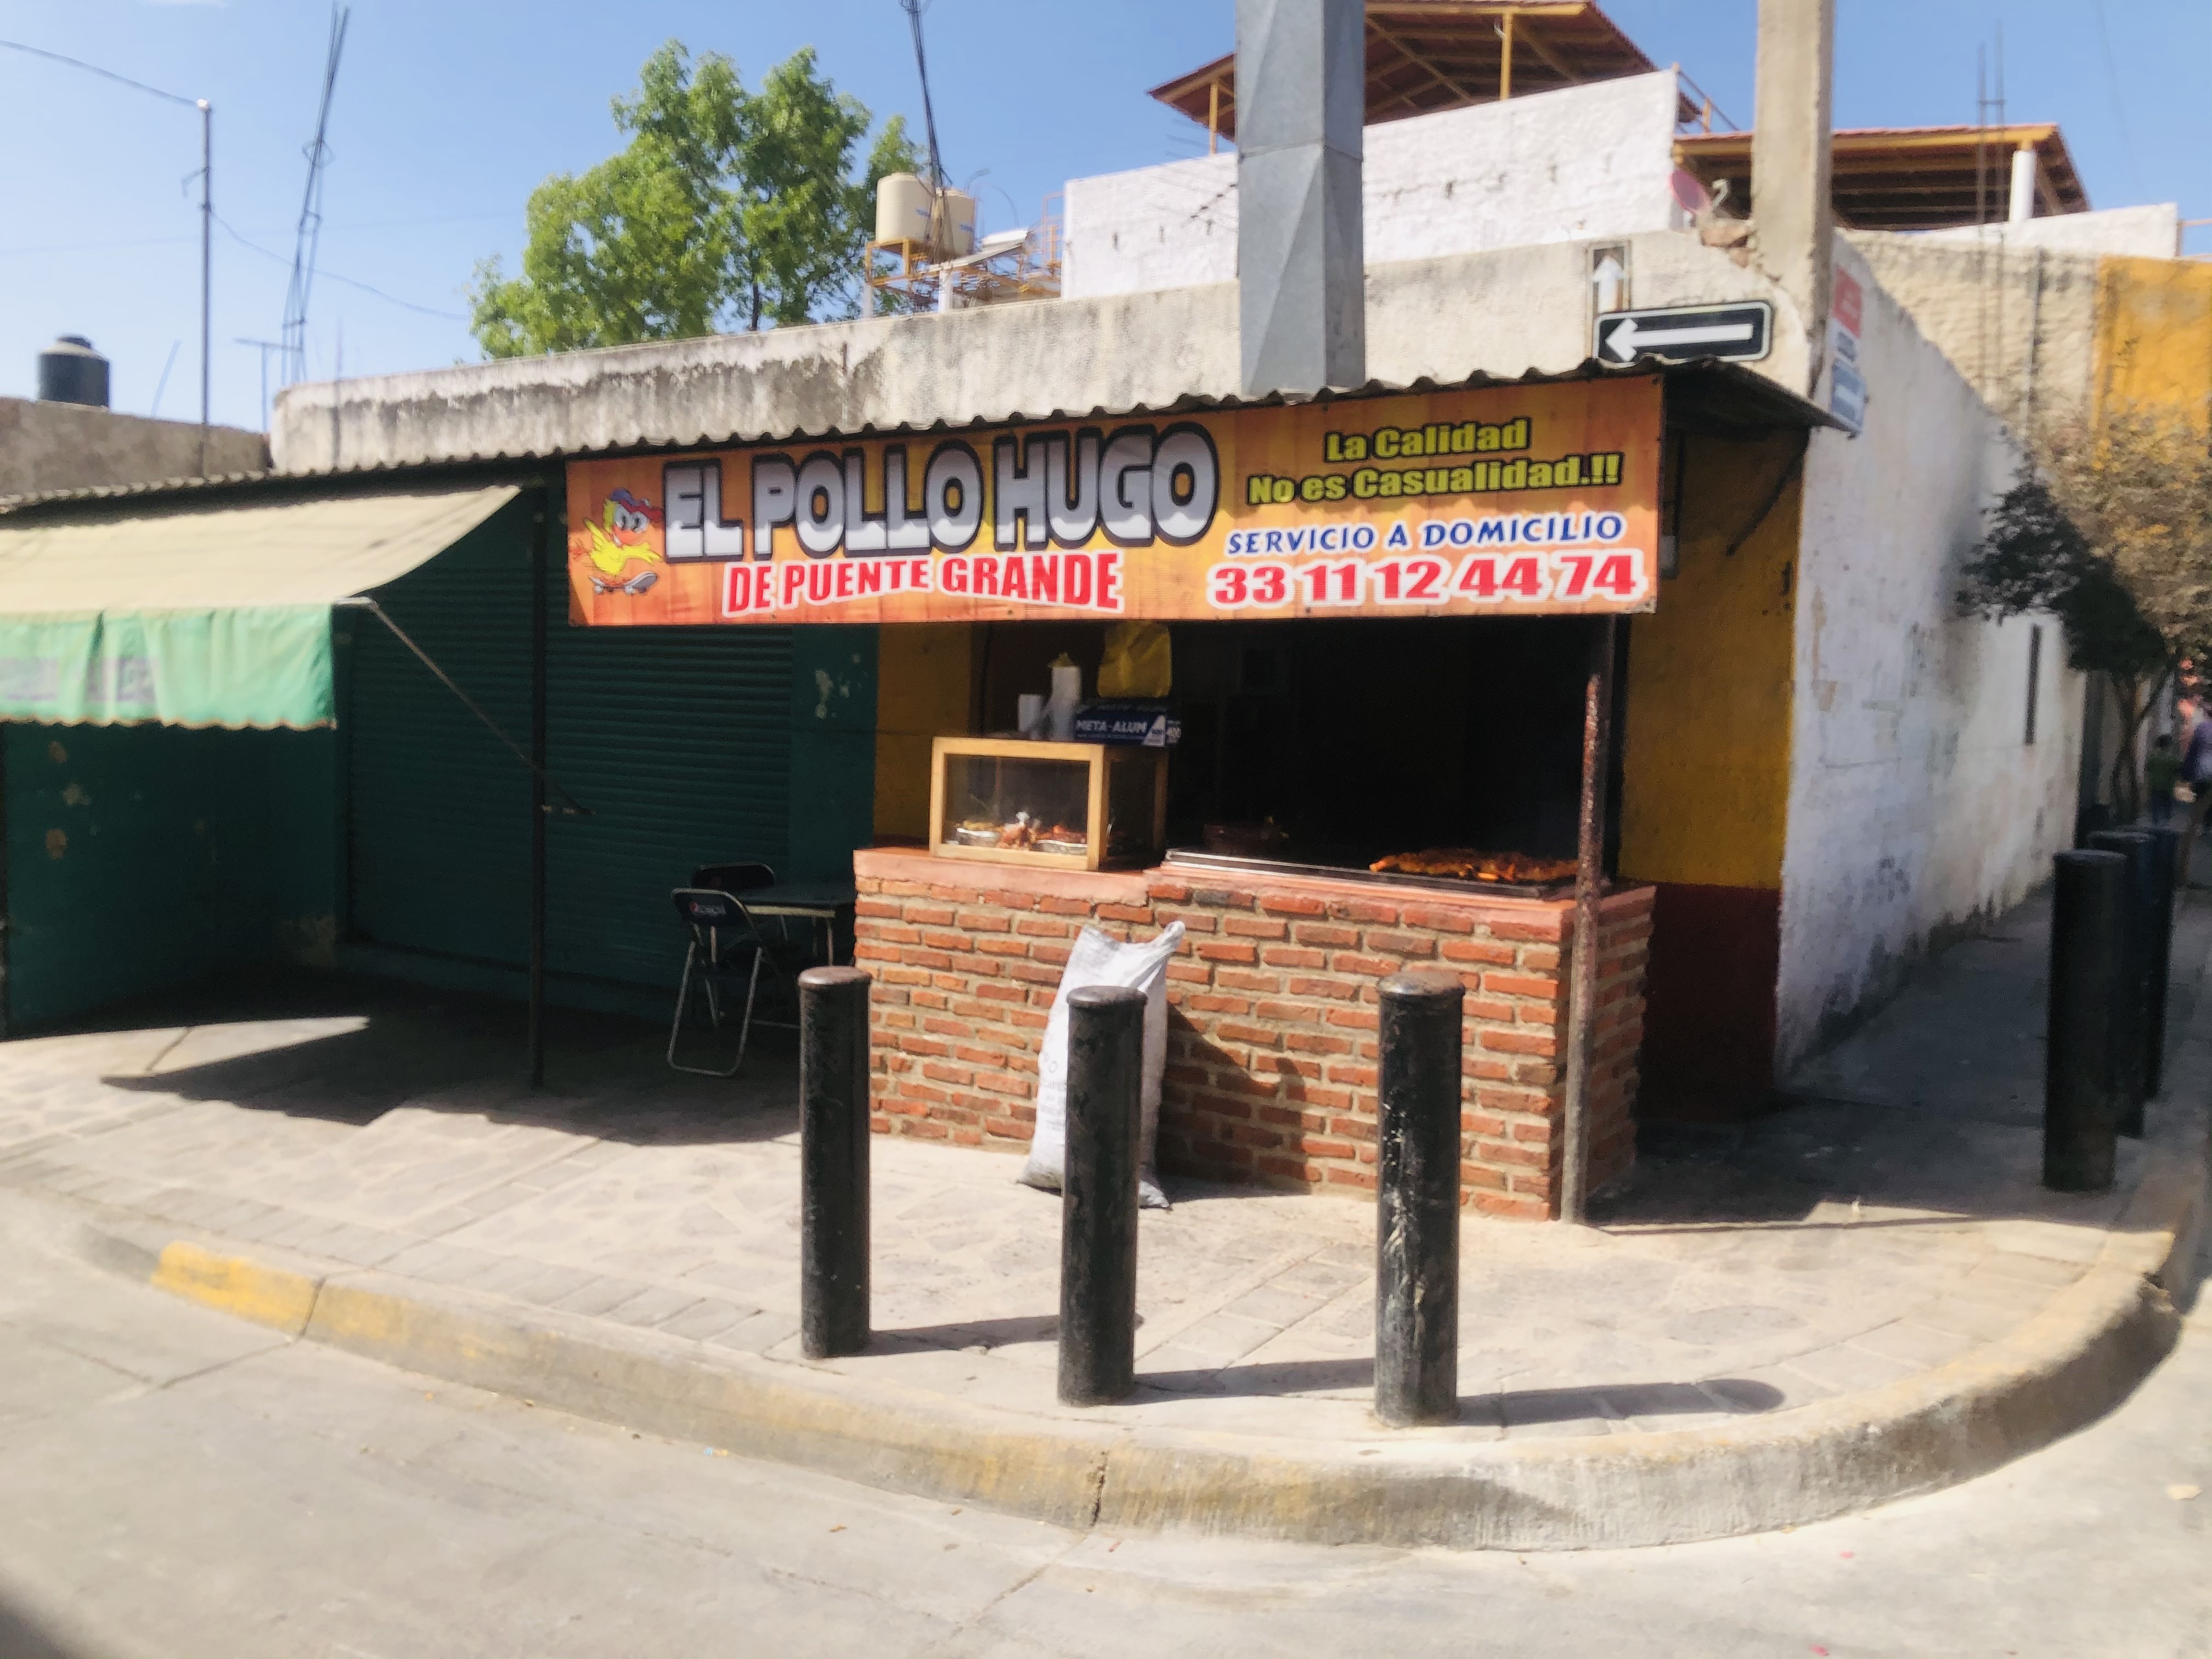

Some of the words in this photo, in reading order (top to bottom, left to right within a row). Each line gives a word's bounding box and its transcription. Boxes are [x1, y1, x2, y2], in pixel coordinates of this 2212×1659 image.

[1327, 432, 1367, 462] La
[1375, 419, 1528, 458] Calidad
[663, 457, 743, 563] EL
[752, 439, 984, 561] POLLO
[993, 421, 1219, 551] HUGO
[1248, 475, 1296, 505] No
[1300, 476, 1347, 501] es
[1353, 453, 1622, 498] Casualidad.!!
[1229, 526, 1375, 554] SERVICIO
[1387, 523, 1408, 548] A
[1424, 515, 1623, 548] DOMICILIO
[726, 563, 772, 613] DE
[782, 560, 928, 606] PUENTE
[941, 552, 1118, 609] GRANDE
[1214, 566, 1285, 603] 33
[1303, 562, 1357, 601] 11
[1375, 560, 1443, 599] 12
[1459, 557, 1543, 596] 44
[1561, 554, 1637, 595] 74
